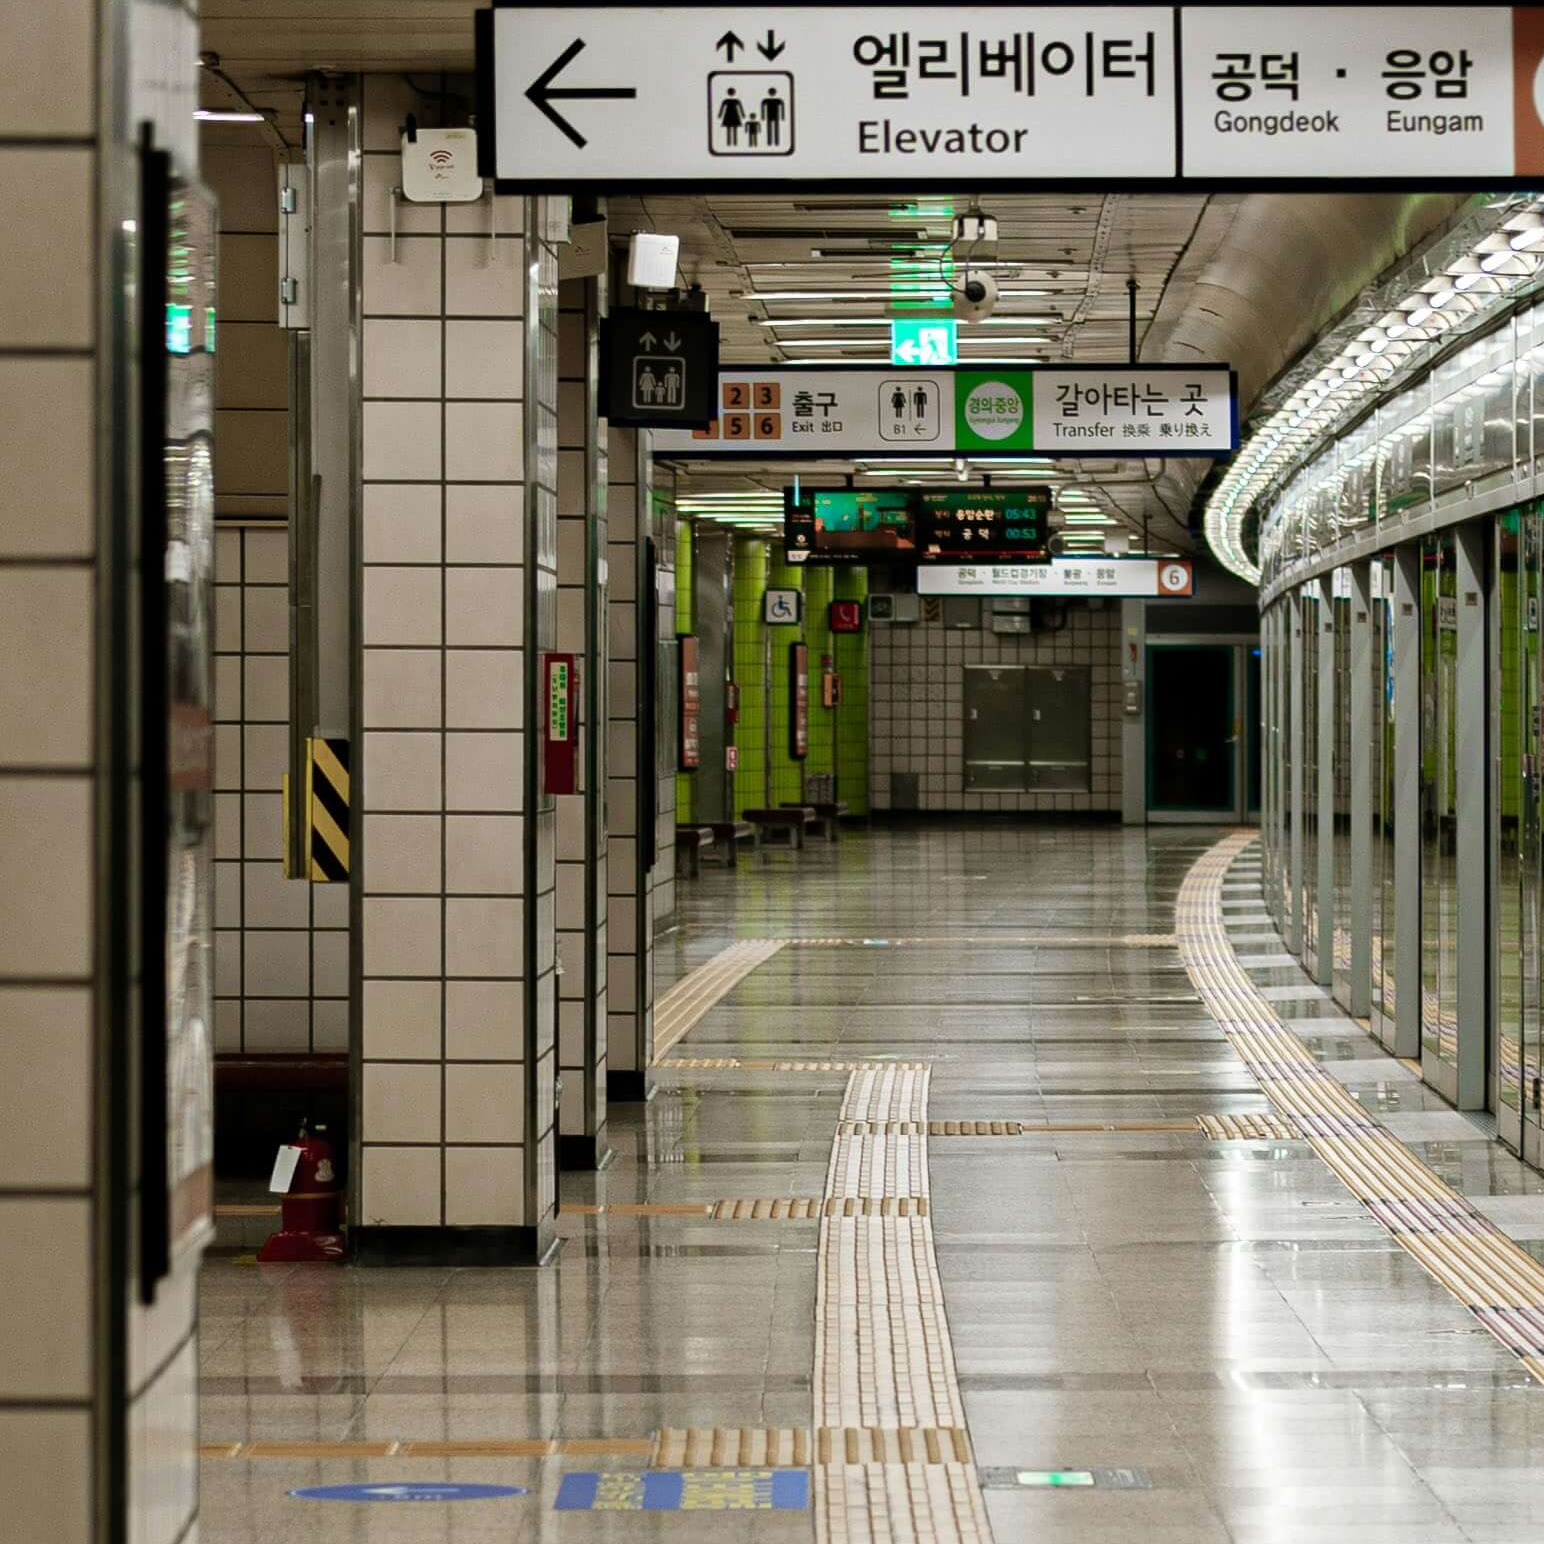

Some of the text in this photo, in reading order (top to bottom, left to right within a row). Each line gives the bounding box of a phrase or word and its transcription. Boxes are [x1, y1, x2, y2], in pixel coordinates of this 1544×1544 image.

[853, 31, 1155, 99] 엘리베이터
[1211, 49, 1473, 102] 공덕 응암
[1214, 110, 1483, 135] Gongdeok Eungam
[859, 119, 1028, 154] Elevator
[730, 386, 773, 405] 2 3
[792, 391, 838, 417] 출구
[1056, 382, 1207, 416] 갈아타는 곳
[731, 417, 773, 435] 5 6
[792, 421, 843, 433] Exit 出口
[1053, 422, 1114, 438] Transfer
[1169, 570, 1179, 584] 6
